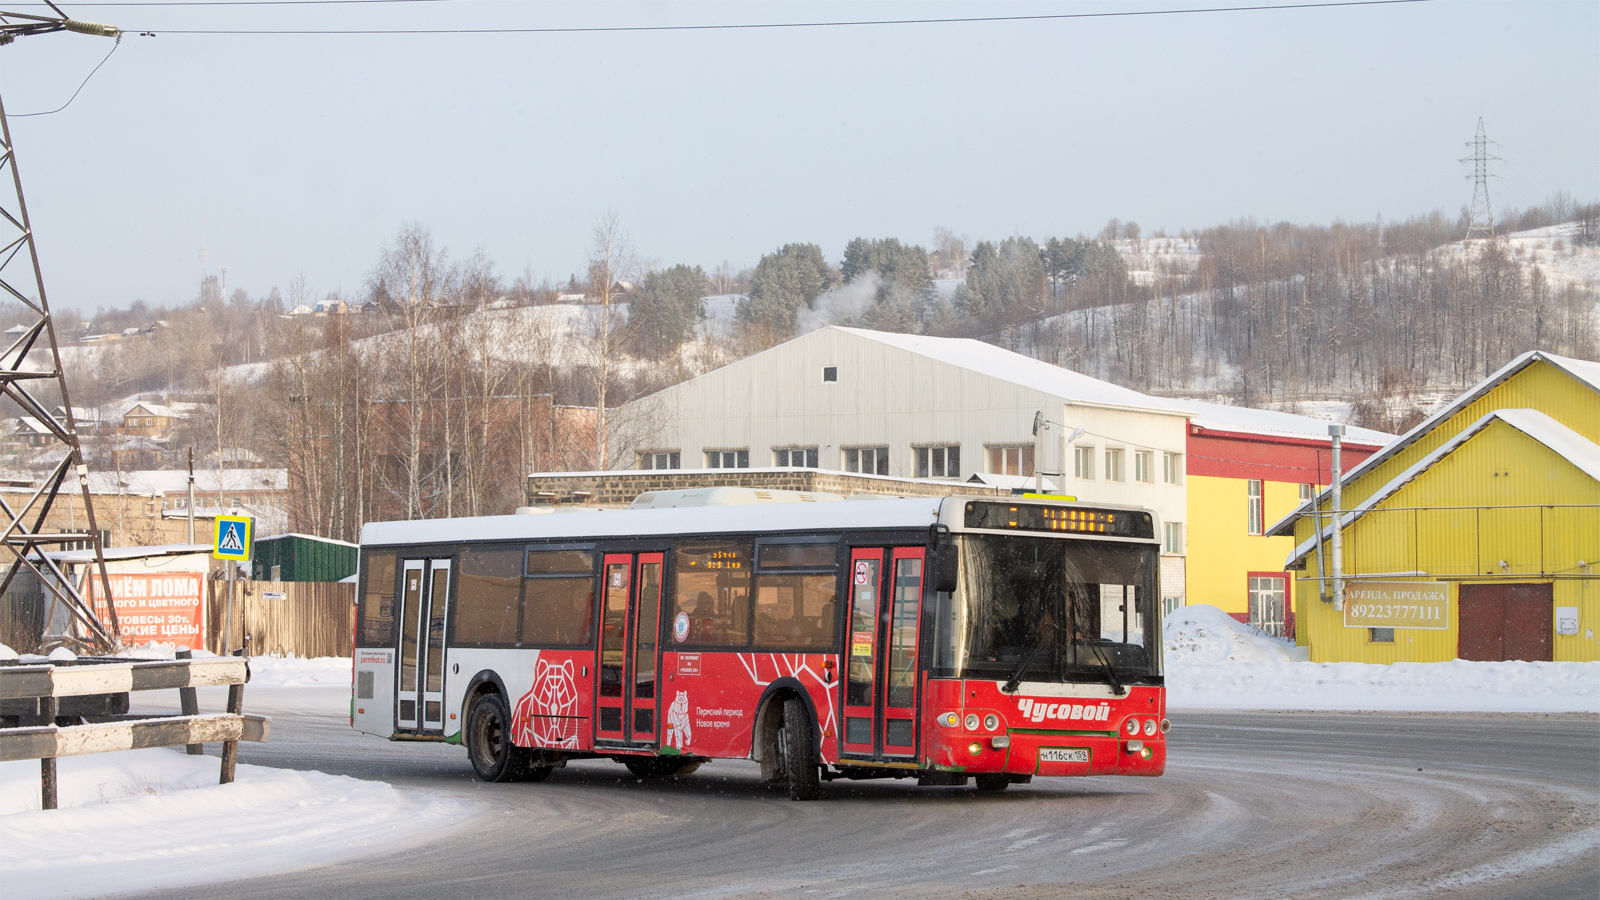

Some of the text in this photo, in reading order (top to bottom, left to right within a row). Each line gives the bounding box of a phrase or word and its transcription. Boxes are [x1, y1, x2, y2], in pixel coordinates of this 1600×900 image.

[150, 578, 199, 597] ЛОМА
[1348, 590, 1445, 601] АРЕНДА, ПРОДАЖА
[139, 599, 146, 607] И
[148, 598, 199, 608] ЦВЕТНОГО
[1351, 603, 1440, 620] 89223777111
[103, 615, 165, 625] АТОВЕСЫ
[161, 624, 199, 636] ЦЕНЫ
[697, 707, 743, 717] Пермский период
[1018, 698, 1110, 722] Чусовой
[697, 719, 730, 729] Новое время
